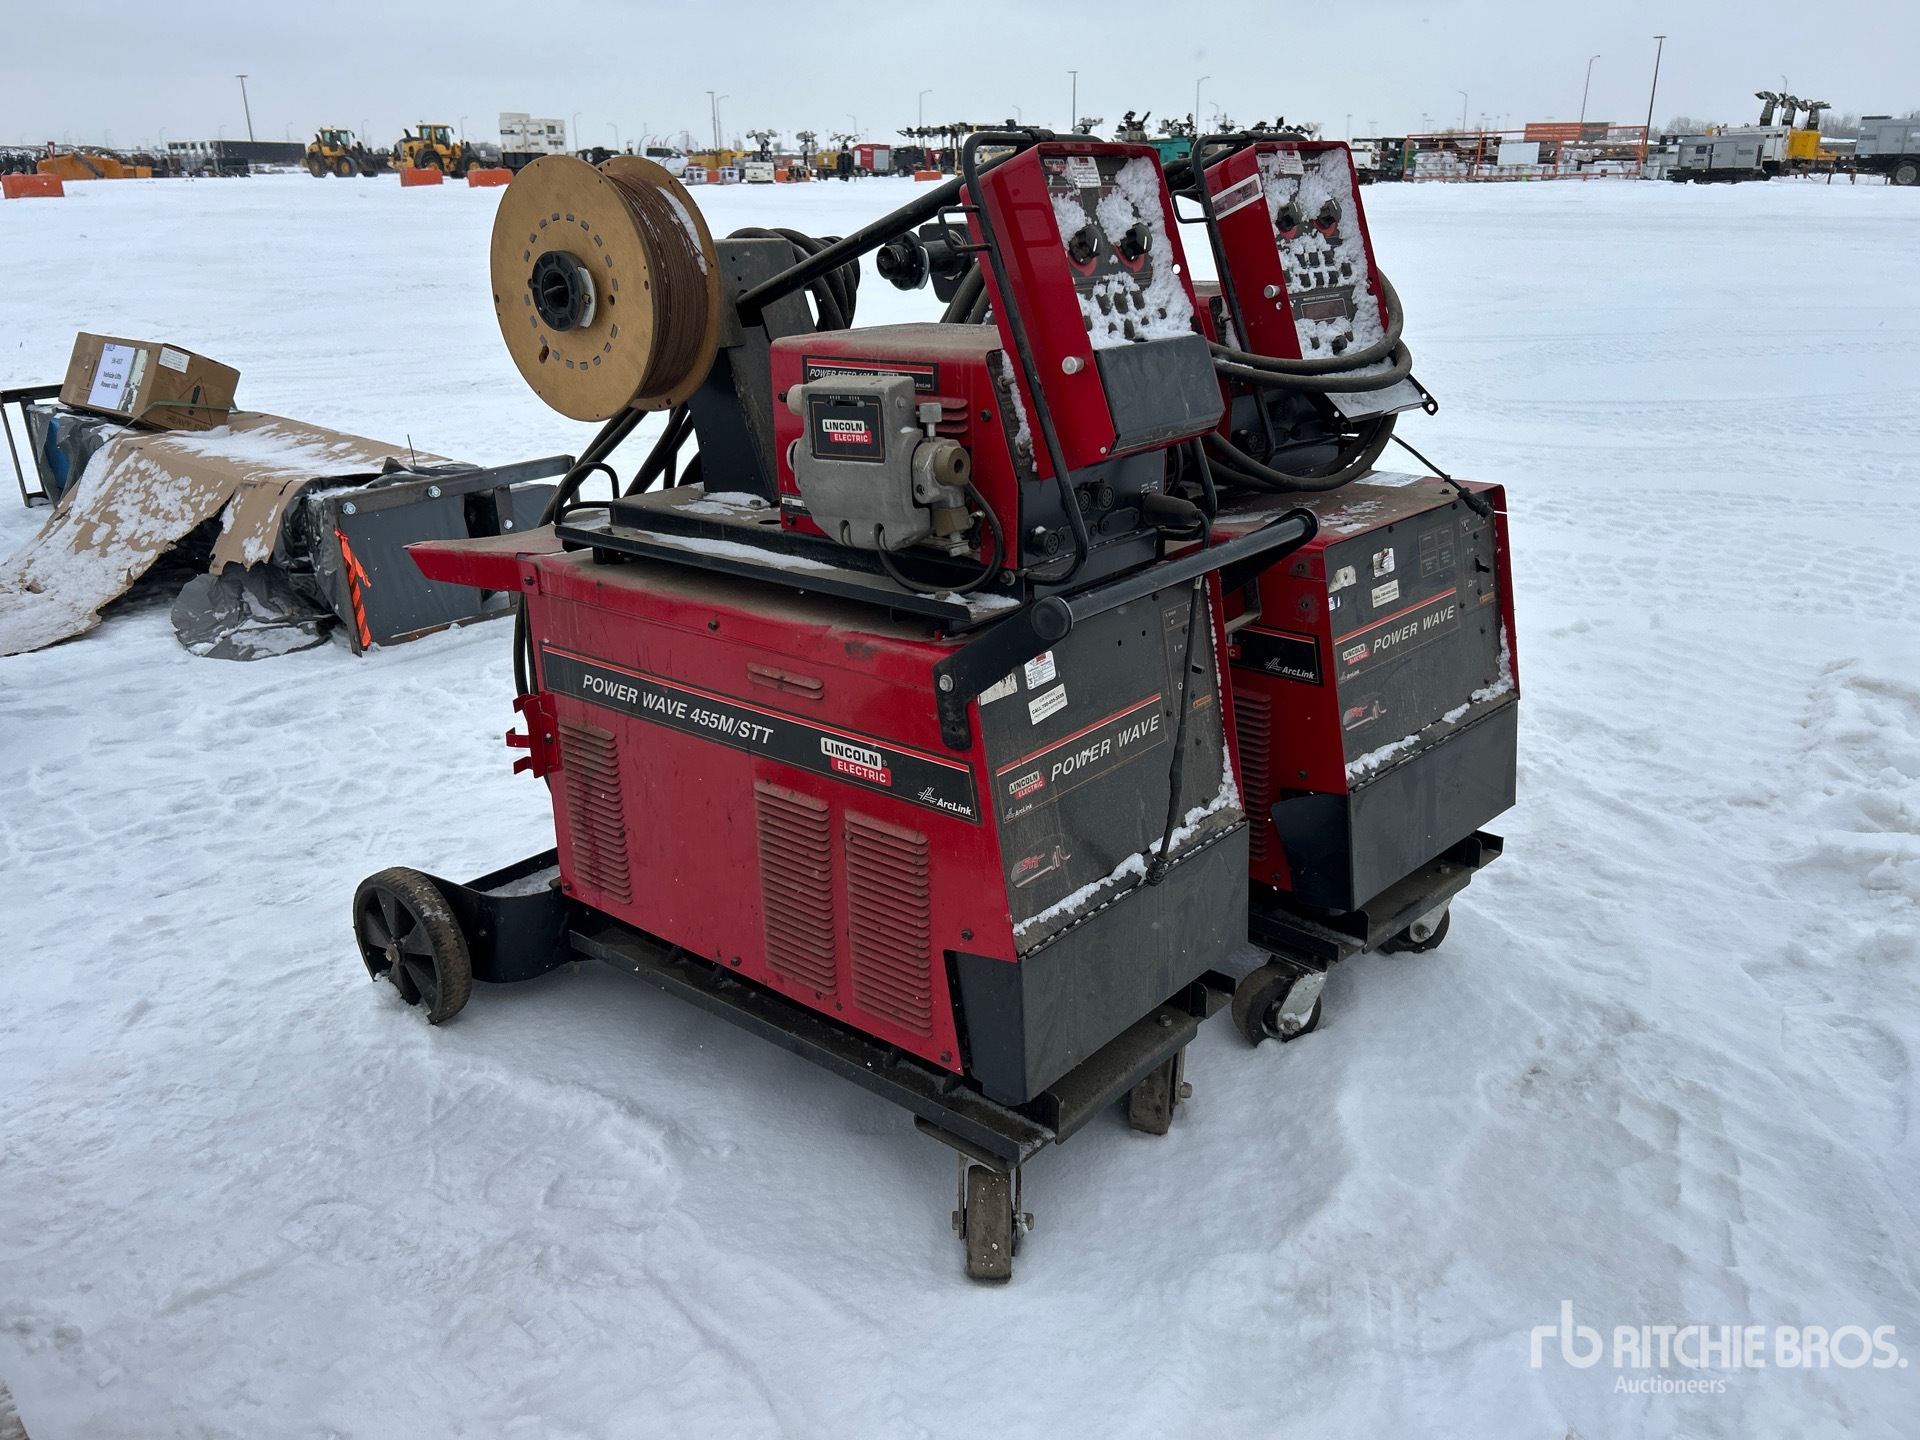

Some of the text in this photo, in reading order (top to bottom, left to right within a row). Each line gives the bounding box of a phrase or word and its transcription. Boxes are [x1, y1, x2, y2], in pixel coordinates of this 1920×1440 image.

[809, 368, 837, 377] POWER
[824, 421, 863, 432] LINCOLN
[834, 433, 868, 443] ELECTRIC
[1373, 605, 1455, 654] POWER WAVE
[1343, 645, 1365, 659] LINCOLN
[1281, 666, 1315, 680] ArcLink
[583, 674, 774, 744] POWER WAVE 455M/STT
[1032, 707, 1042, 715] CALL
[824, 741, 879, 767] LINCOLN
[1051, 713, 1160, 782] POWER WAVE
[837, 760, 886, 783] ELECTRIC
[1010, 772, 1039, 793] LINCOLN
[1018, 780, 1043, 798] ELECTRIC
[937, 798, 972, 816] ArcLink
[1015, 803, 1033, 817] ArcLink
